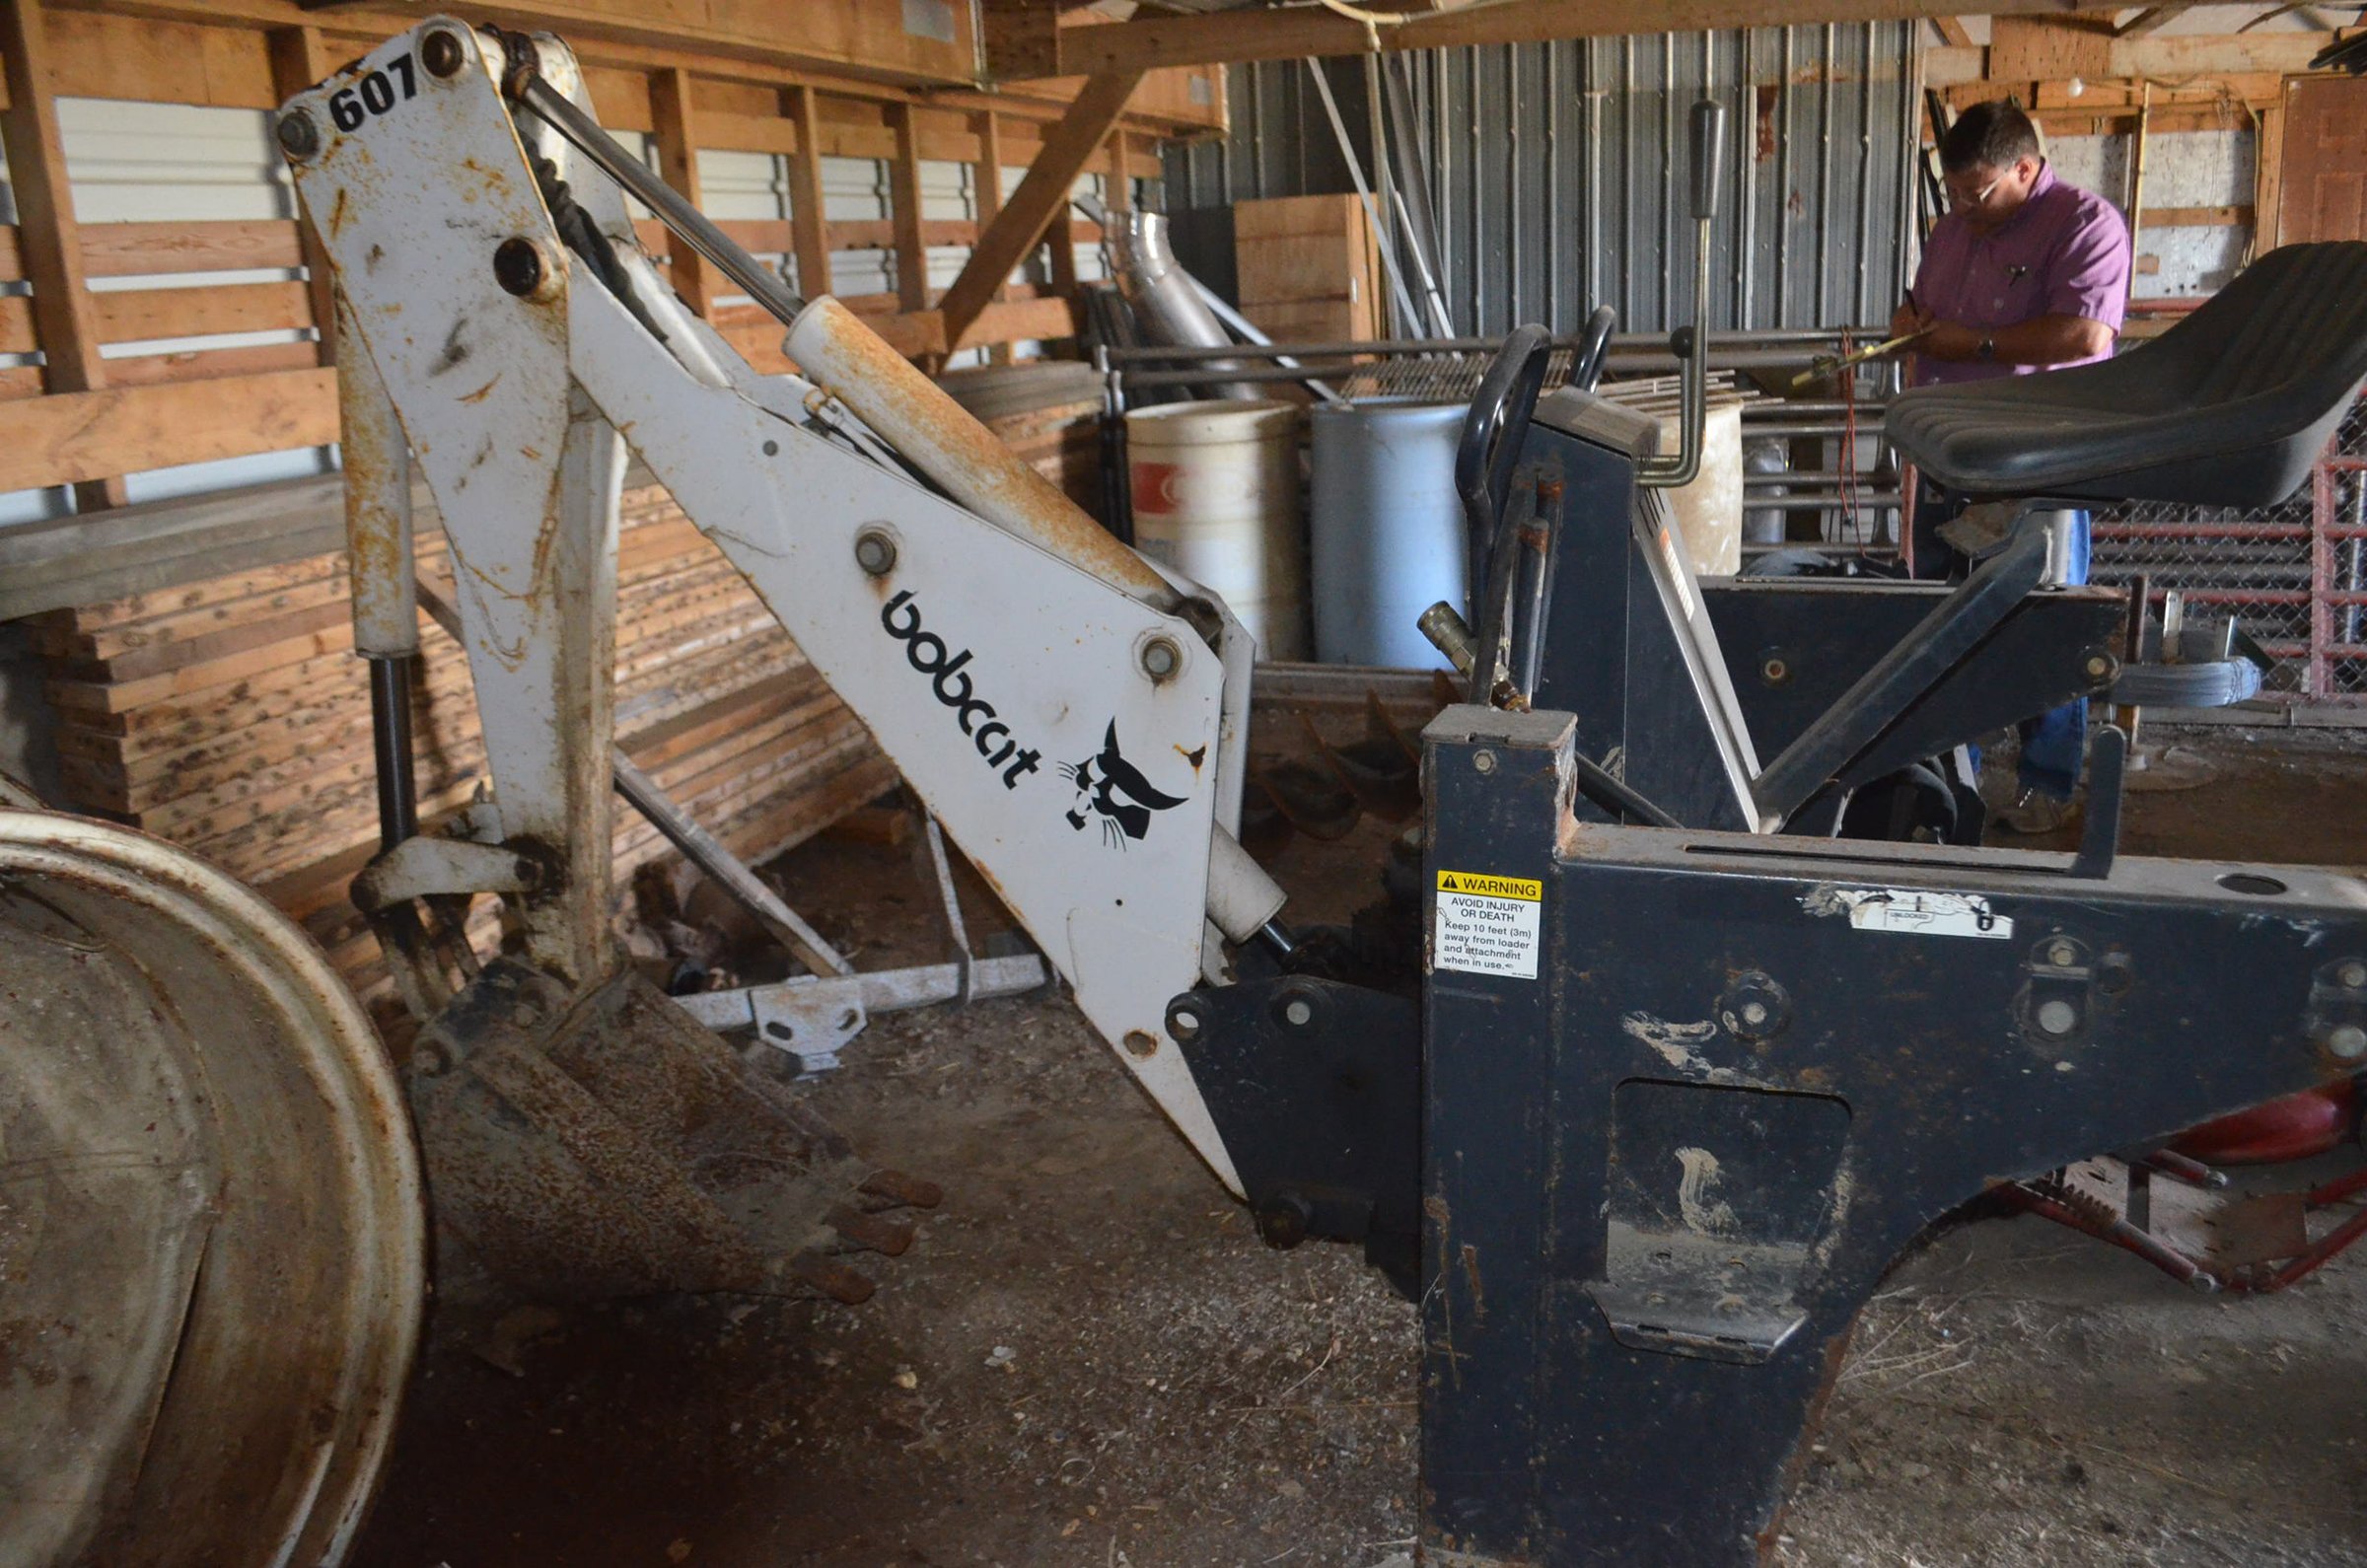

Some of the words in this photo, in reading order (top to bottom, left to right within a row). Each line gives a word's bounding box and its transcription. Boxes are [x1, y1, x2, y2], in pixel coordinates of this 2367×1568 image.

[329, 52, 416, 132] 607
[881, 590, 1041, 791] bobcat
[1463, 878, 1537, 896] WARNING
[1451, 897, 1483, 907] AVOID
[1486, 901, 1525, 912] INJURY
[1461, 908, 1476, 918] OR
[1479, 910, 1514, 922] DEATH
[1445, 921, 1470, 931] Keep
[1473, 924, 1484, 933] 10
[1488, 925, 1507, 935] feet
[1510, 929, 1532, 939] (3m)
[1445, 933, 1470, 946] away
[1472, 936, 1495, 945] from
[1498, 939, 1530, 949] loader
[1444, 945, 1462, 954] and
[1466, 947, 1521, 961] attachment
[1444, 956, 1470, 965] when
[1484, 961, 1505, 969] use.
